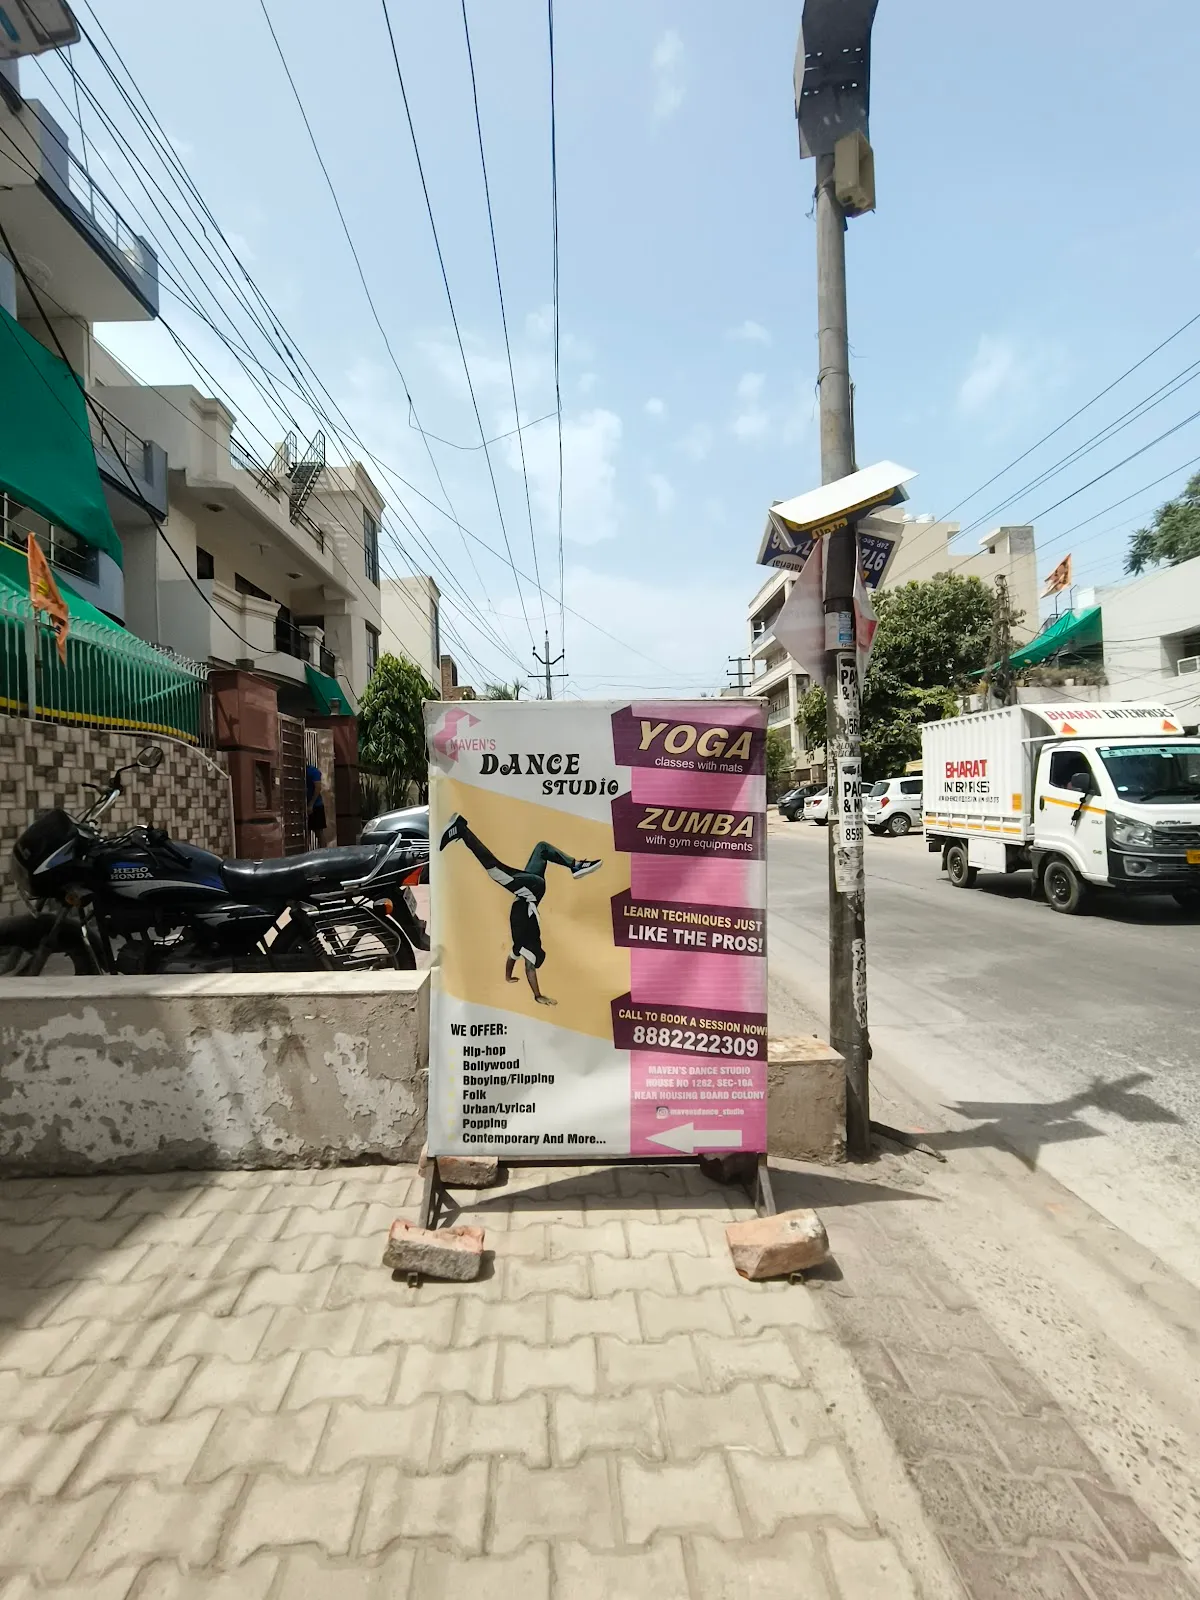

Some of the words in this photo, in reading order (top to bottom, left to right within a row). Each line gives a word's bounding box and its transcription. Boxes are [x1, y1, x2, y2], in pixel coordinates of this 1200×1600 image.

[1044, 710, 1103, 720] BHARAT
[450, 738, 496, 751] MAVEN'S
[638, 720, 753, 760] YOGA
[479, 754, 580, 776] DANCE
[654, 756, 695, 768] classes
[698, 762, 717, 771] with
[719, 764, 744, 773] mats
[946, 759, 988, 778] BHARAT
[844, 799, 852, 812] &
[637, 808, 754, 838] ZUMBA
[646, 835, 666, 845] with
[669, 838, 691, 848] gym
[694, 839, 753, 852] equipments
[624, 906, 659, 919] LEARN
[662, 909, 732, 928] TECHNIQUES
[734, 918, 762, 932] JUST
[628, 924, 668, 942] LIKE
[673, 928, 707, 946] THE
[712, 932, 764, 953] PROS!
[618, 1009, 642, 1020] CALL
[645, 1012, 658, 1022] TO
[660, 1014, 688, 1026] BOOK
[690, 1017, 697, 1027] A
[699, 1018, 740, 1033] SESSION
[450, 1024, 467, 1036] WE
[470, 1024, 508, 1036] OFFER:
[633, 1026, 759, 1058] 8882222309
[463, 1046, 506, 1058] Hip-hop
[463, 1059, 520, 1072] Bollywood
[648, 1066, 687, 1075] MAVEN'S
[689, 1066, 718, 1076] DANCE
[720, 1066, 751, 1076] STUDIO
[463, 1073, 555, 1086] Bboying/Flipping
[646, 1078, 675, 1088] HOUSE
[676, 1078, 689, 1088] NO
[463, 1090, 487, 1100] Folk
[634, 1091, 658, 1100] NEAR
[660, 1091, 698, 1100] HOUSING
[700, 1091, 730, 1100] BOARD
[732, 1091, 765, 1100] COLONY
[463, 1102, 536, 1115] Urban/Lyrical
[463, 1118, 508, 1130] Popping
[462, 1132, 540, 1145] Contemporary
[542, 1134, 564, 1144] And
[568, 1134, 606, 1144] More...
